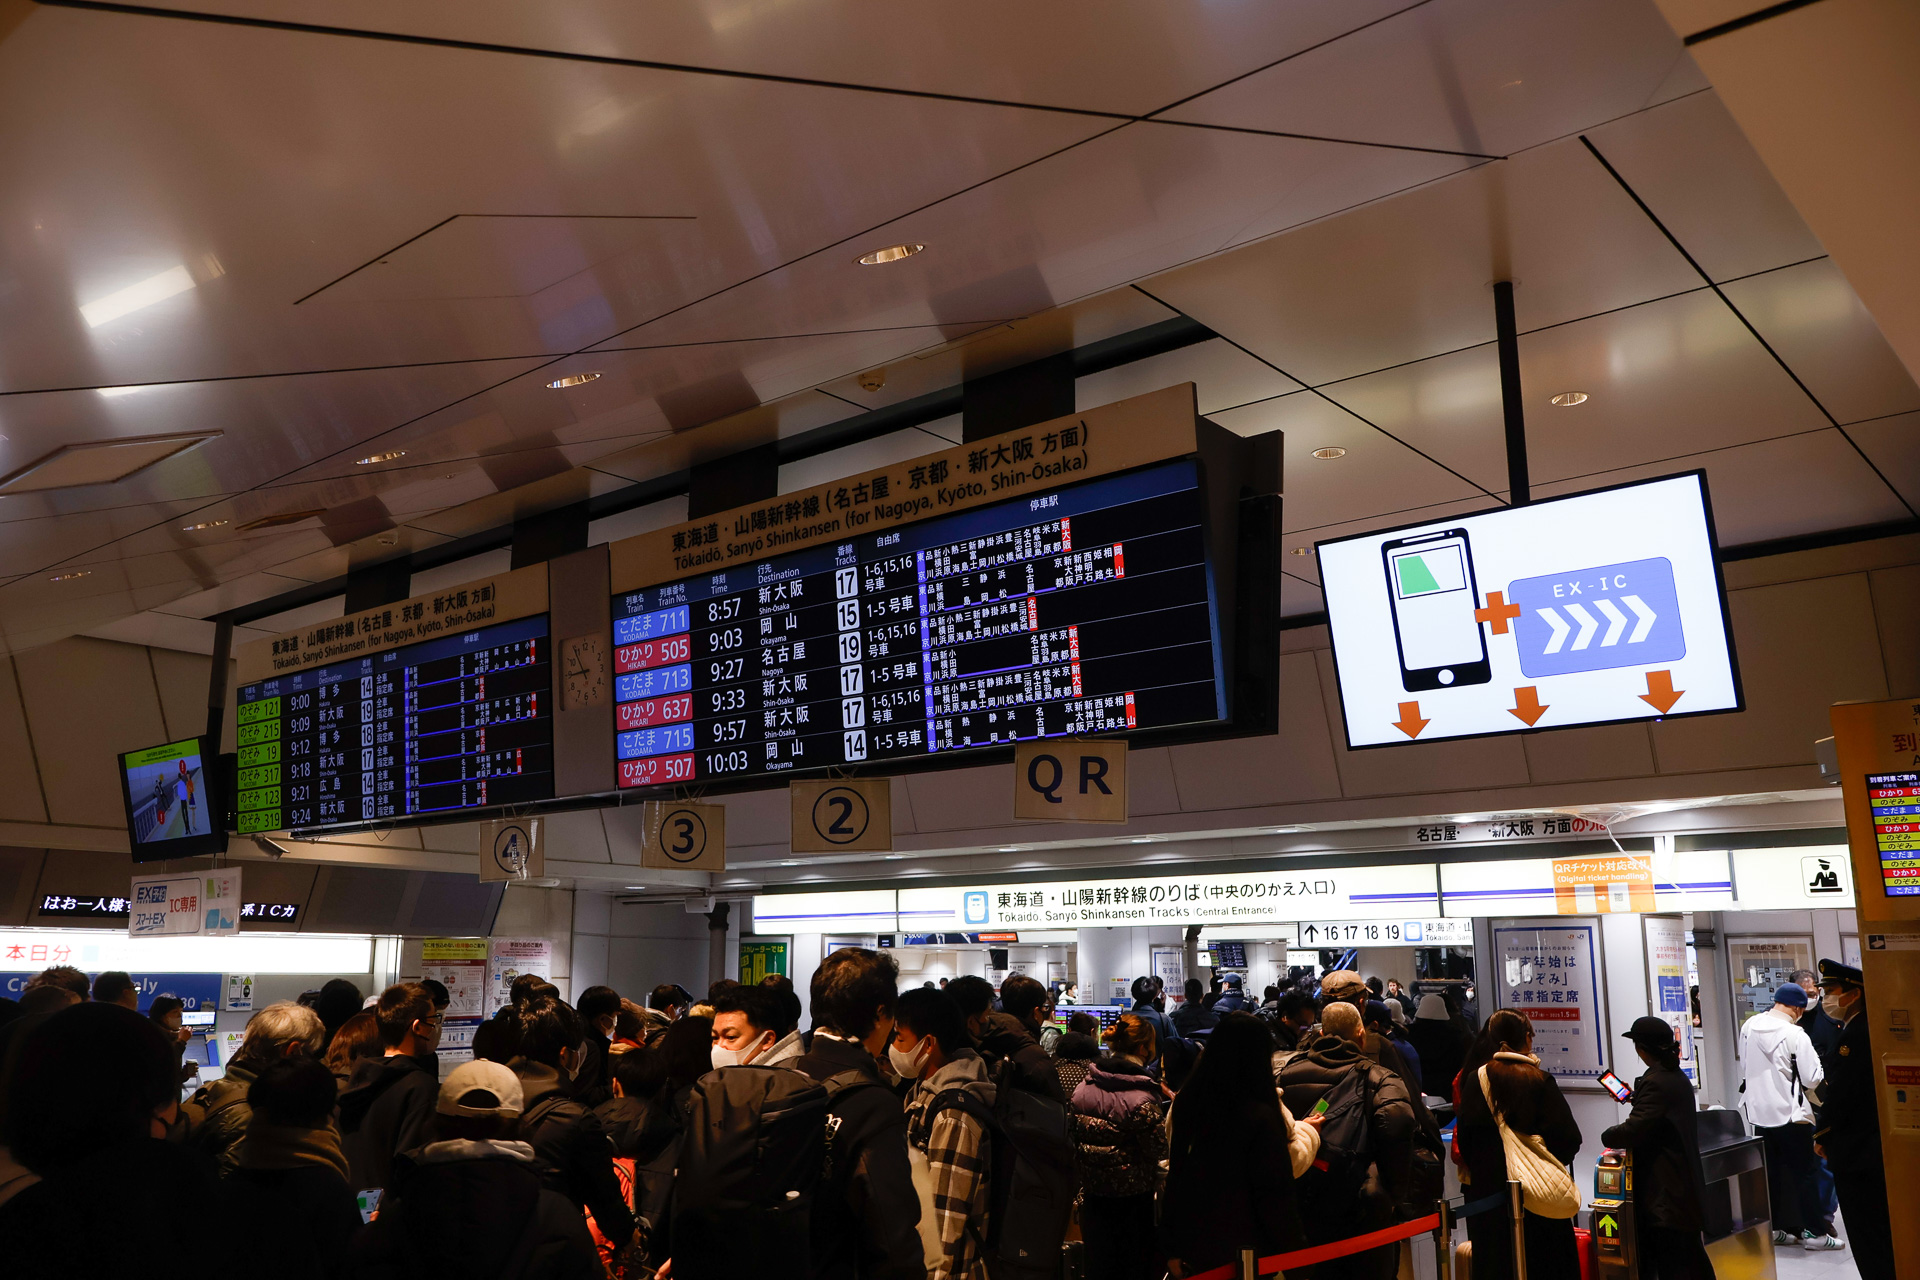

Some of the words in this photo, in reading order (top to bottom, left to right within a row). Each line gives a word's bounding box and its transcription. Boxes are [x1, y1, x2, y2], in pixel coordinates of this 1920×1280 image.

[674, 547, 724, 571] Tōkaidō,
[727, 536, 763, 557] Sanyō
[766, 519, 840, 555] Shinkansen
[845, 509, 872, 531] (for
[875, 495, 933, 521] Nagoya,
[937, 481, 986, 507] Kyōto,
[991, 450, 1088, 491] Shin-Ōsaka)
[1030, 495, 1059, 512] 停車駅
[876, 532, 901, 547] 自由席
[834, 553, 857, 566] Tracks
[757, 563, 773, 575] 行先
[757, 567, 800, 584] Destination
[711, 573, 727, 586] 時刻
[864, 577, 886, 593] 号車
[1553, 574, 1627, 599] EX-IC
[619, 614, 652, 634] こだま
[660, 609, 687, 631] 711
[708, 598, 742, 622] 8:57
[758, 579, 803, 605] 新大阪
[837, 571, 857, 597] 17
[864, 556, 913, 577] 1-6,15,16
[711, 583, 728, 594] Time
[627, 602, 644, 613] Train
[658, 595, 674, 606] Train
[675, 594, 689, 603] No.
[758, 601, 790, 615] Shin-Ōsaka
[620, 644, 653, 663] ひかり
[661, 638, 688, 661] 505
[709, 628, 743, 652] 9:03
[760, 612, 798, 635] 岡山
[839, 602, 859, 628] 15
[866, 603, 886, 618] 1-5
[888, 594, 914, 614] 号車
[273, 651, 302, 671] Tōkaidō,
[302, 646, 322, 663] Sanyō
[324, 638, 366, 661] Shinkansen
[367, 632, 381, 648] (for
[383, 626, 415, 647] Nagoya,
[416, 618, 442, 639] Kyōto,
[444, 604, 495, 632] Shin-Ōsaka)
[623, 630, 650, 643] KODAMA
[760, 634, 787, 646] Okayama
[621, 671, 654, 691] こだま
[661, 667, 689, 691] 713
[710, 658, 744, 682] 9:27
[761, 641, 806, 666] 名古屋
[839, 635, 860, 661] 19
[867, 622, 917, 644] 1-6,15,16
[868, 642, 889, 658] 号車
[627, 660, 647, 670] HIKARI
[761, 666, 784, 677] Nagoya
[621, 701, 655, 720] ひかり
[662, 698, 690, 720] 637
[711, 689, 746, 712] 9:33
[762, 673, 808, 697] 新大阪
[841, 667, 862, 693] 17
[870, 667, 890, 684] 1-5
[892, 661, 917, 679] 号車
[624, 688, 651, 699] KODAMA
[240, 704, 260, 716] のぞみ
[264, 701, 280, 716] 121
[291, 694, 310, 711] 9:00
[319, 683, 340, 700] 博多
[762, 695, 795, 708] Shin-Ōsaka
[240, 726, 260, 738] のぞみ
[263, 722, 280, 738] 215
[291, 716, 310, 733] 9:09
[319, 706, 344, 722] 新大阪
[623, 729, 656, 749] こだま
[663, 726, 692, 749] 715
[713, 719, 747, 743] 9:57
[763, 705, 809, 729] 新大阪
[842, 700, 863, 726] 17
[871, 689, 921, 710] 1-6,15,16
[628, 717, 649, 727] HIKARI
[871, 708, 893, 724] 号車
[764, 727, 796, 739] Shin-Ōsaka
[240, 748, 260, 759] のぞみ
[267, 745, 277, 760] 19
[291, 740, 310, 756] 9:12
[319, 730, 340, 746] 博多
[1892, 733, 1920, 752] 到
[623, 759, 657, 778] ひかり
[665, 757, 692, 779] 507
[706, 750, 748, 774] 10:03
[765, 737, 804, 760] 岡山
[844, 732, 865, 758] 14
[873, 734, 893, 750] 1-5
[896, 729, 922, 748] 号車
[626, 746, 653, 757] KODAMA
[240, 770, 260, 781] のぞみ
[264, 767, 280, 782] 317
[291, 762, 310, 779] 9:18
[319, 753, 344, 769] 新大阪
[765, 759, 793, 770] Okayama
[631, 775, 651, 785] HIKARI
[1028, 754, 1114, 804] QR
[1869, 774, 1917, 783] 到着列車ご案内
[240, 792, 260, 803] のぞみ
[264, 789, 280, 805] 123
[291, 785, 310, 802] 9:21
[320, 777, 341, 793] 広島
[1879, 789, 1903, 797] ひかり
[240, 814, 260, 825] のぞみ
[264, 811, 280, 827] 319
[291, 808, 311, 825] 9:24
[319, 801, 345, 816] 新大阪
[1883, 807, 1906, 815] こだま
[1885, 825, 1910, 833] ひかり
[1891, 851, 1914, 859] こだま
[1554, 859, 1650, 874] QRチケット対応改札
[1893, 869, 1917, 877] ひかり
[1587, 873, 1609, 882] ticket
[170, 896, 197, 913] IC専用
[1045, 909, 1078, 922] Sanyō
[1080, 907, 1145, 920] Shinkansen
[1149, 905, 1190, 918] Tracks
[1192, 905, 1229, 917] (Central
[1232, 903, 1277, 916] Entrance)
[1324, 925, 1339, 940] 16
[1343, 925, 1358, 940] 17
[1364, 925, 1379, 940] 18
[1385, 924, 1400, 940] 19
[5, 944, 72, 962] 本日分
[1511, 990, 1579, 1003] 全席指定席
